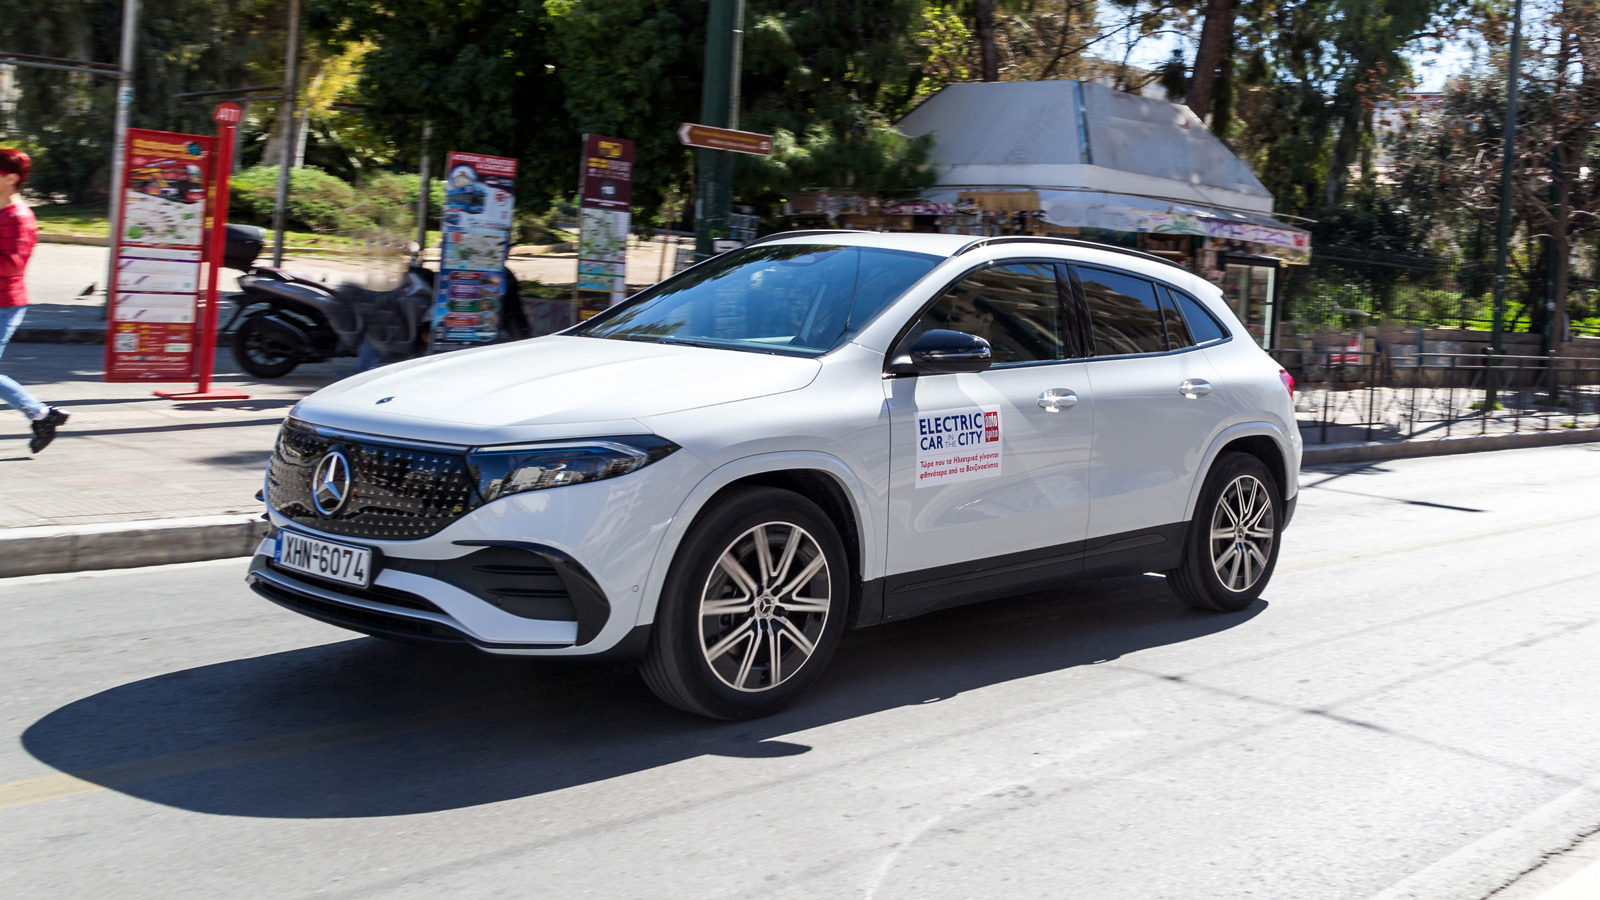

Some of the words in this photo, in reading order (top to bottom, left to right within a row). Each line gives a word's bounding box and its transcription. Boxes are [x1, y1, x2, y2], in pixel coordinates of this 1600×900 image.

[919, 413, 983, 435] ELECTRIC
[920, 436, 943, 450] CAR
[958, 431, 983, 446] CITY
[920, 460, 934, 469] Τώρα
